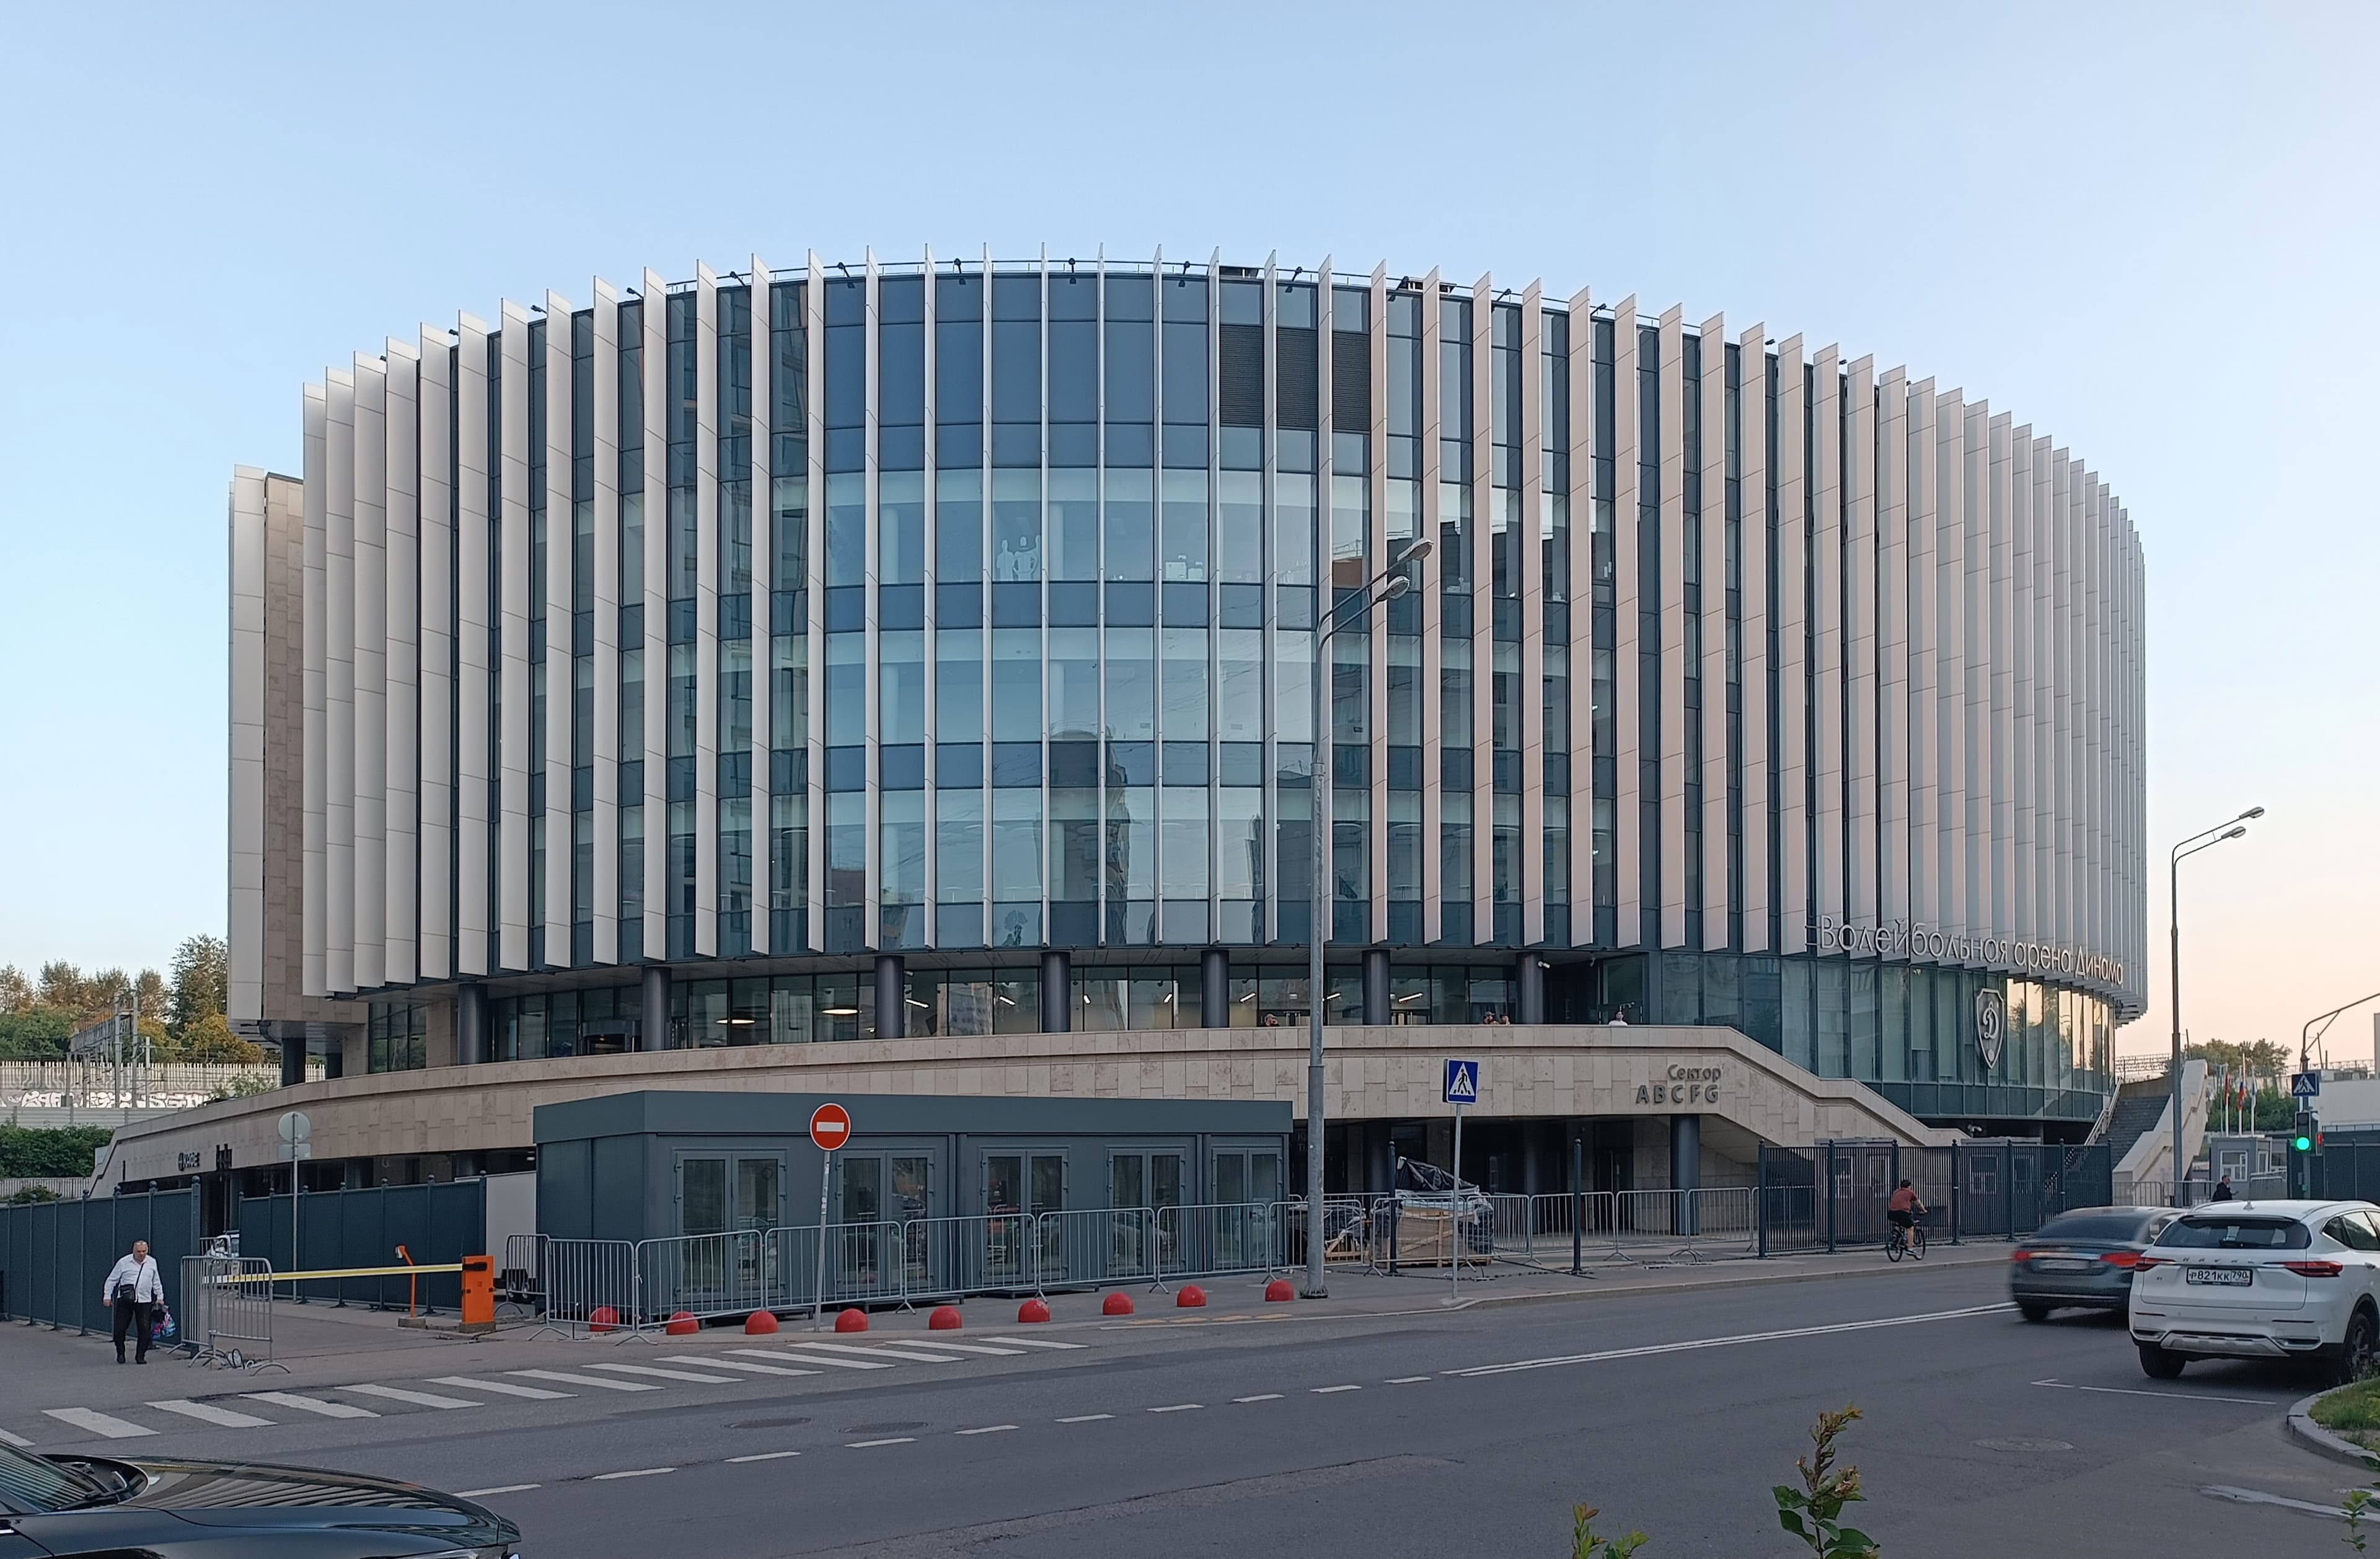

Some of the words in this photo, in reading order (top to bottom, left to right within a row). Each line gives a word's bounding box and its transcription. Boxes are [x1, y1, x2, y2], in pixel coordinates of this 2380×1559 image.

[1820, 914, 2008, 963] Волейбольная
[2014, 942, 2073, 975] арена
[2074, 945, 2123, 987] Динамо
[1668, 1064, 1721, 1082] Сектор
